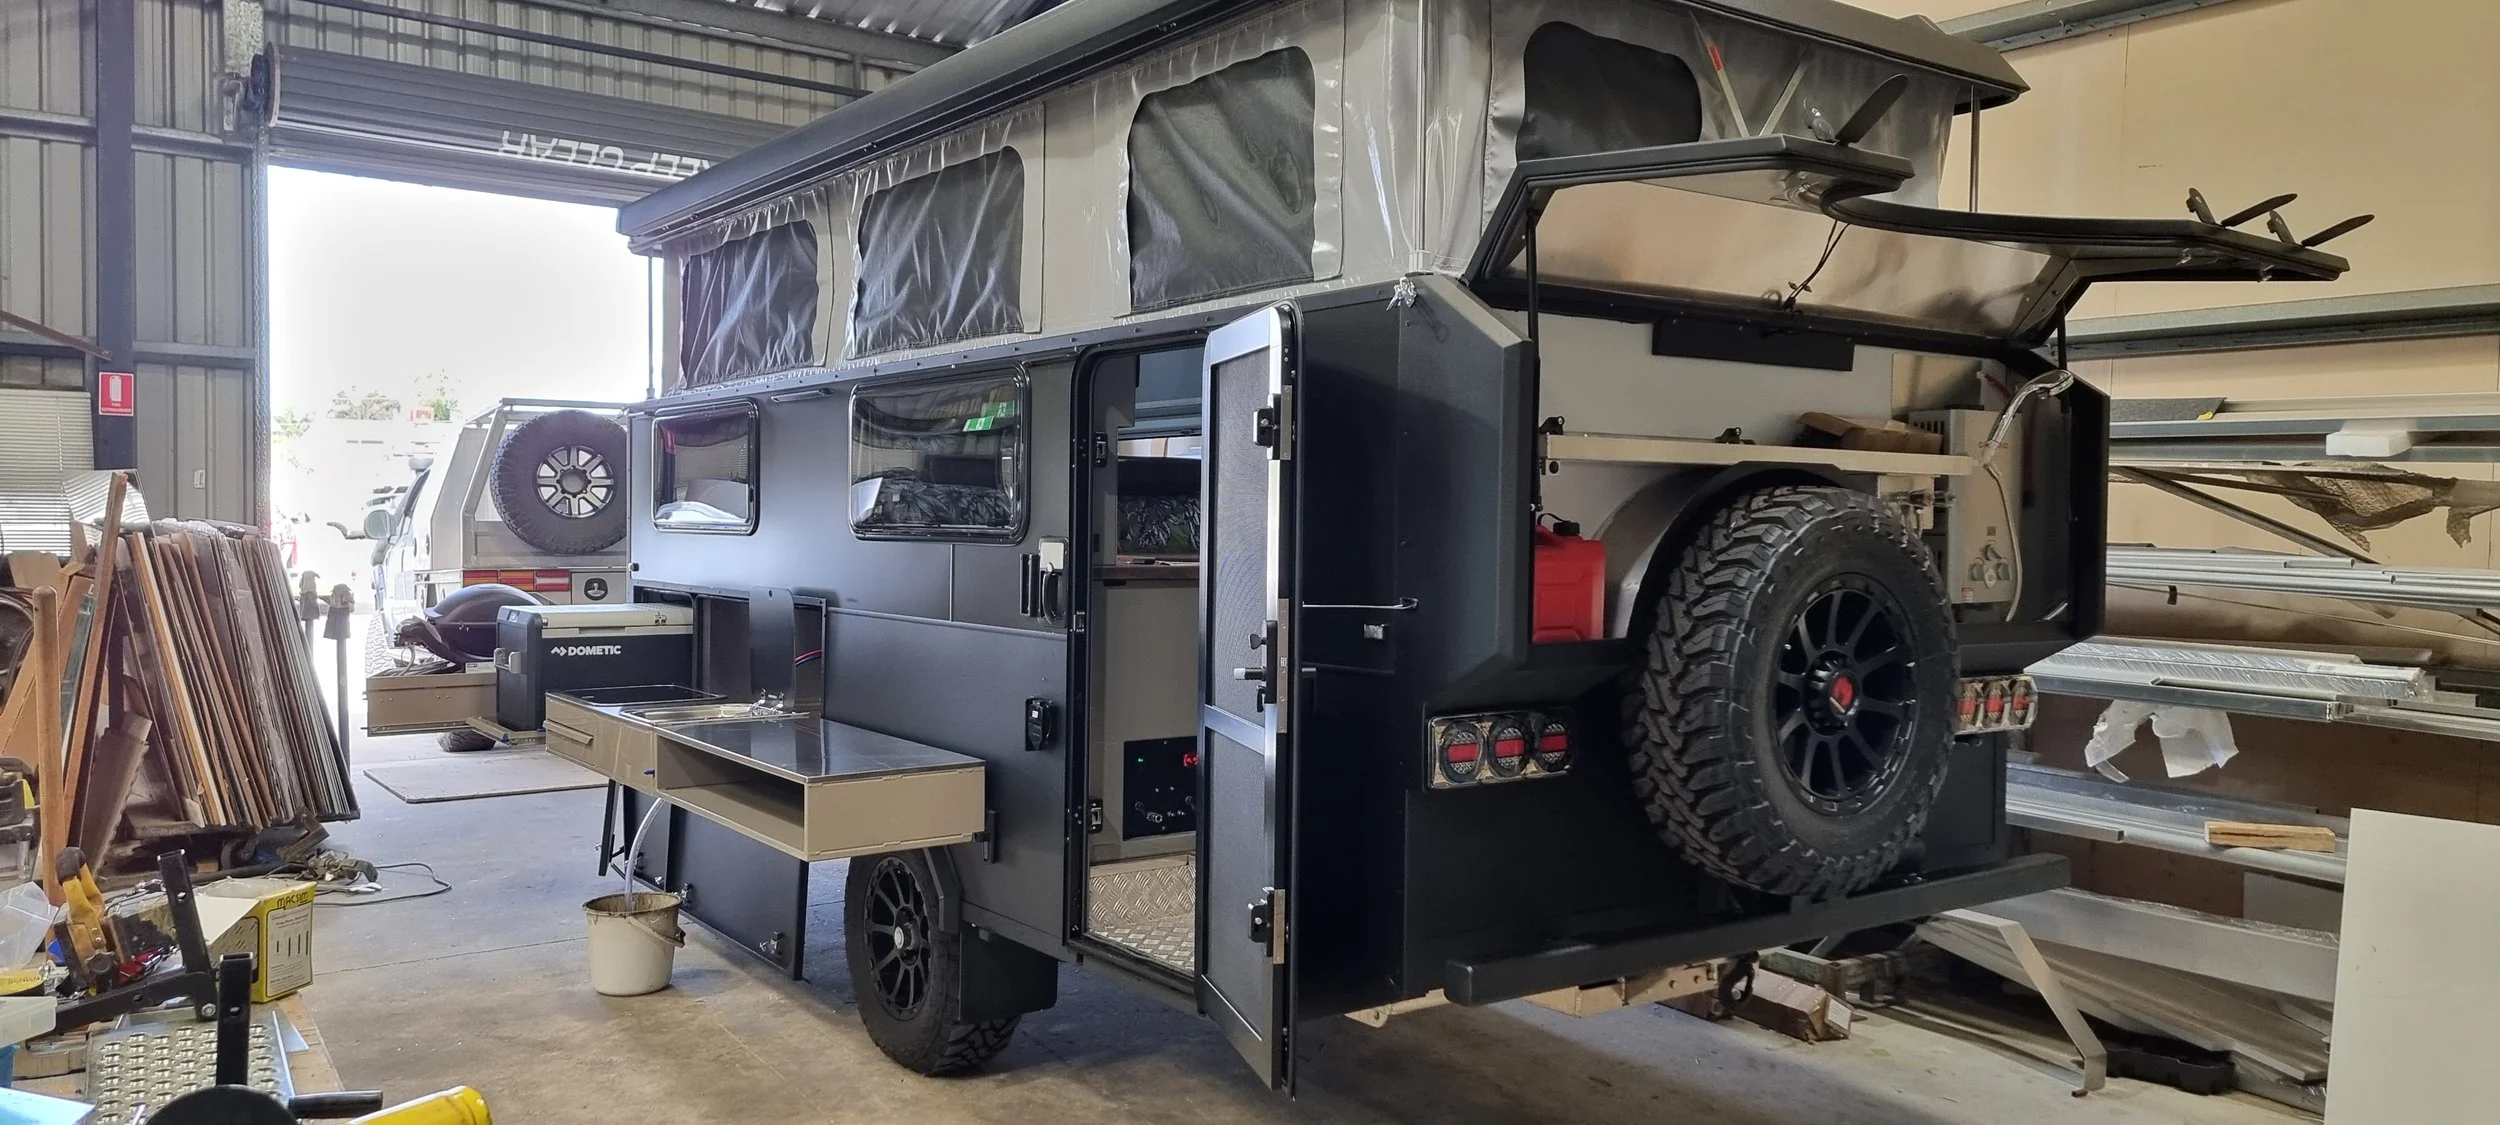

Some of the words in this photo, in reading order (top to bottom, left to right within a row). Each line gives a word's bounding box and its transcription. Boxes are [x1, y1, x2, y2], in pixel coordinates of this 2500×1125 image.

[500, 131, 624, 168] CLEAR
[631, 151, 710, 178] EEP
[568, 645, 622, 656] DOMETIC
